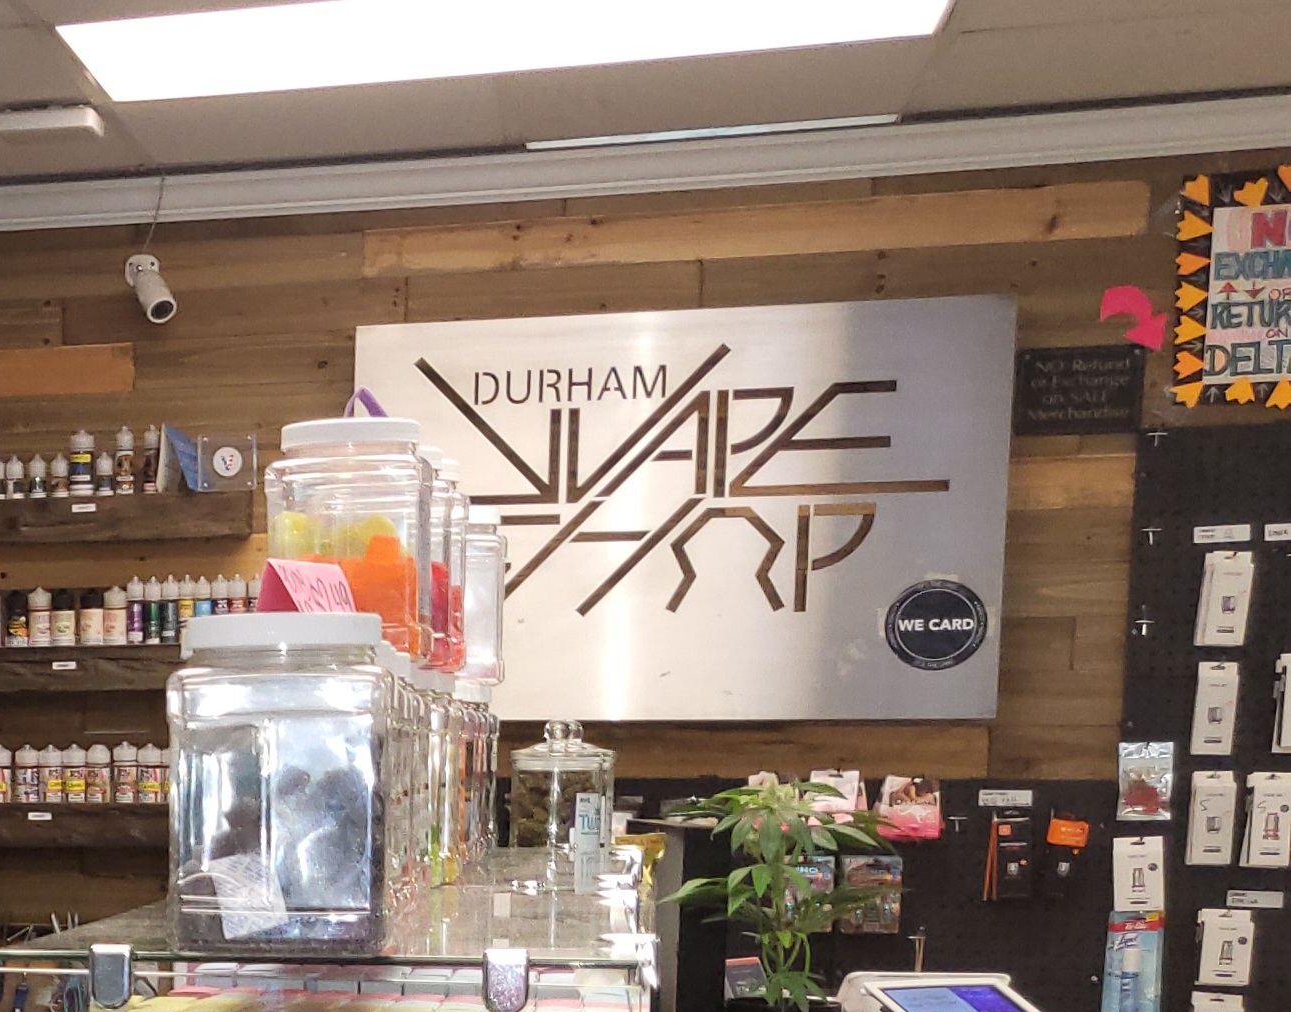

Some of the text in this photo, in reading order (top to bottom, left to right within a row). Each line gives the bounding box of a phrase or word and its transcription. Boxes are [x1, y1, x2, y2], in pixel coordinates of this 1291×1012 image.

[1203, 340, 1291, 377] DELT
[473, 364, 669, 406] DURHAM
[414, 343, 951, 504] VAPE
[898, 618, 975, 631] WE CARD
